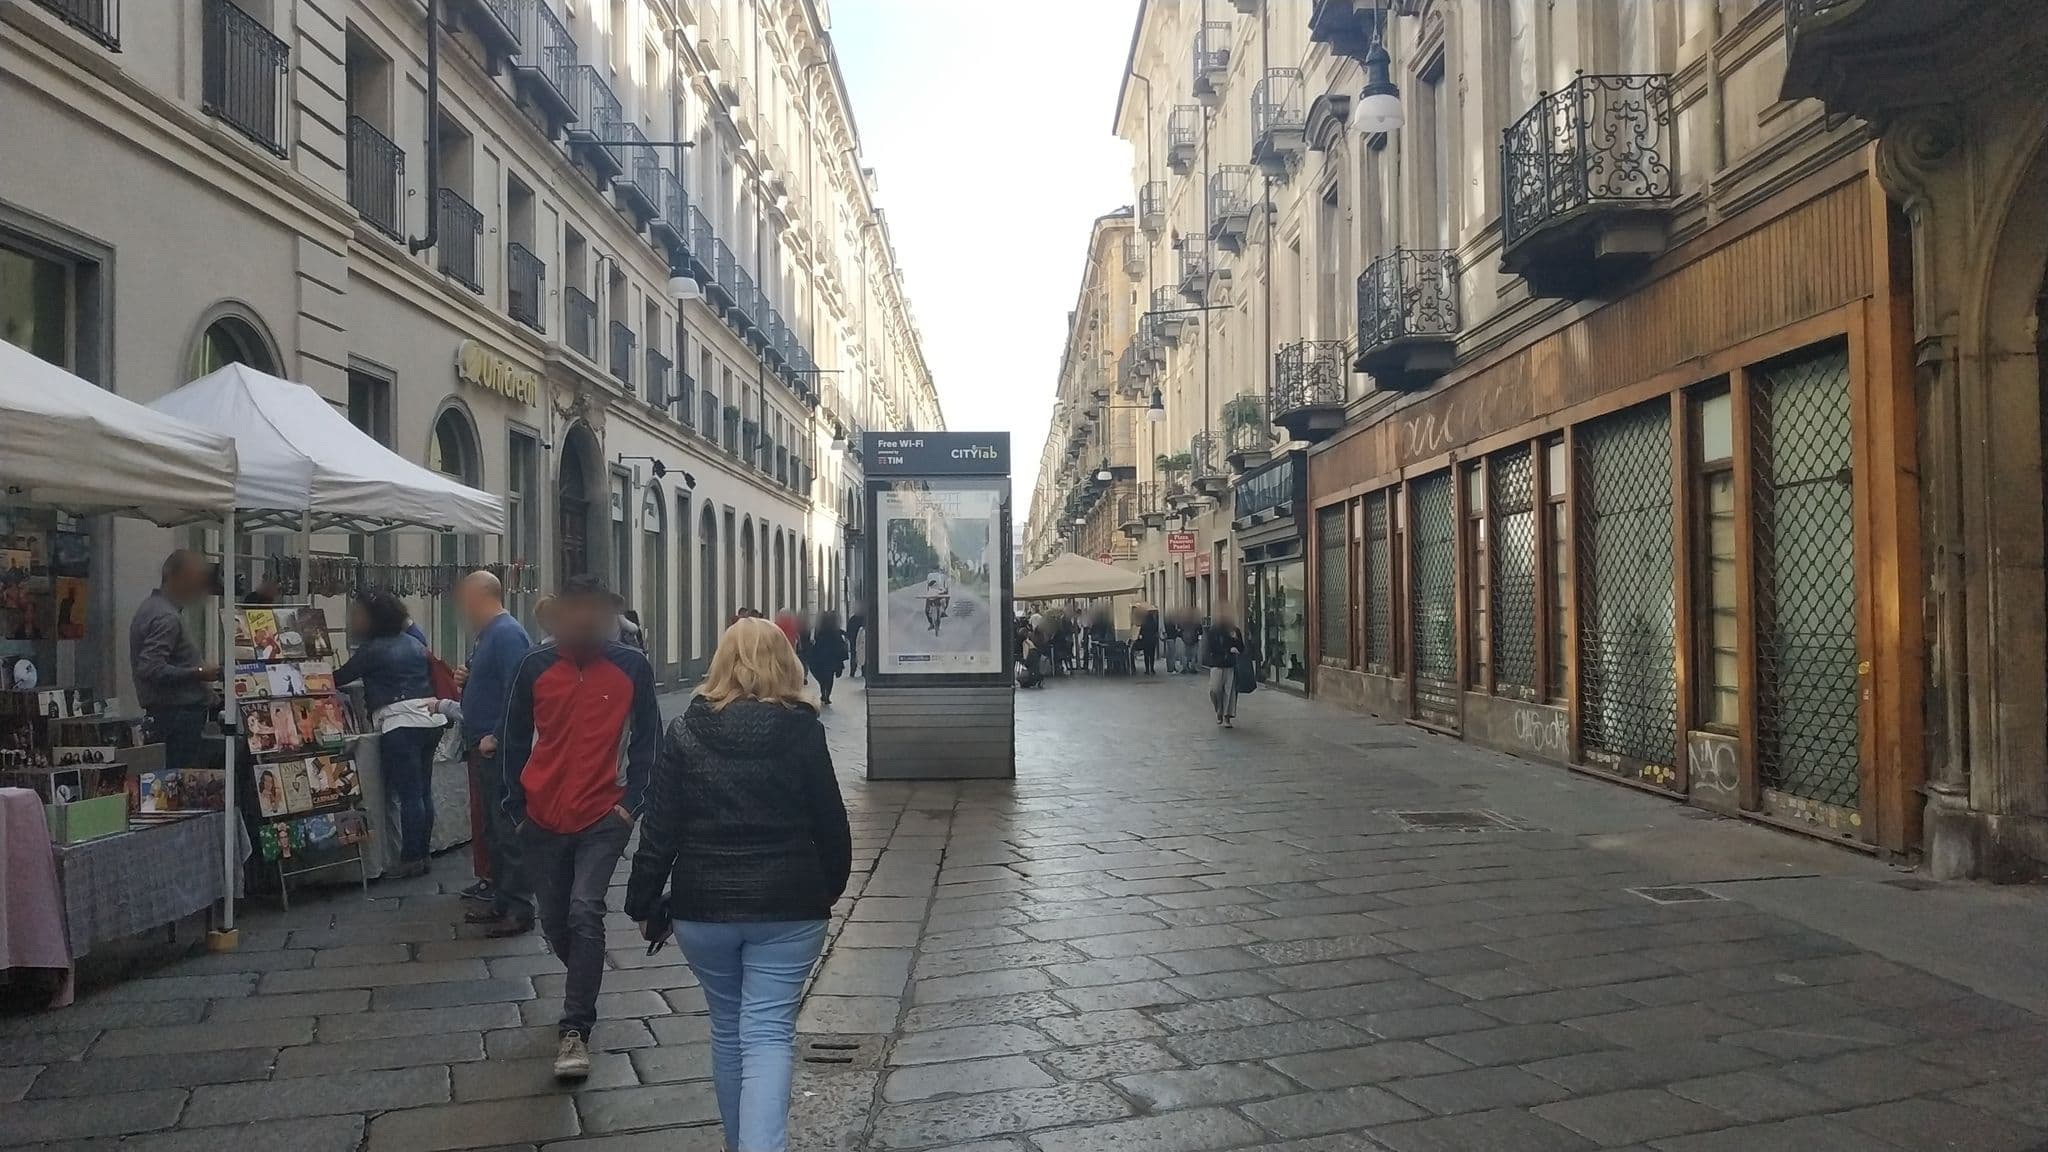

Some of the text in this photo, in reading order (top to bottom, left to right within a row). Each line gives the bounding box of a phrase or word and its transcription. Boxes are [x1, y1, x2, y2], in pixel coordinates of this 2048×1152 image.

[482, 353, 538, 408] UniCredit
[878, 440, 924, 448] Free Wi-Fi
[887, 457, 904, 465] TIM
